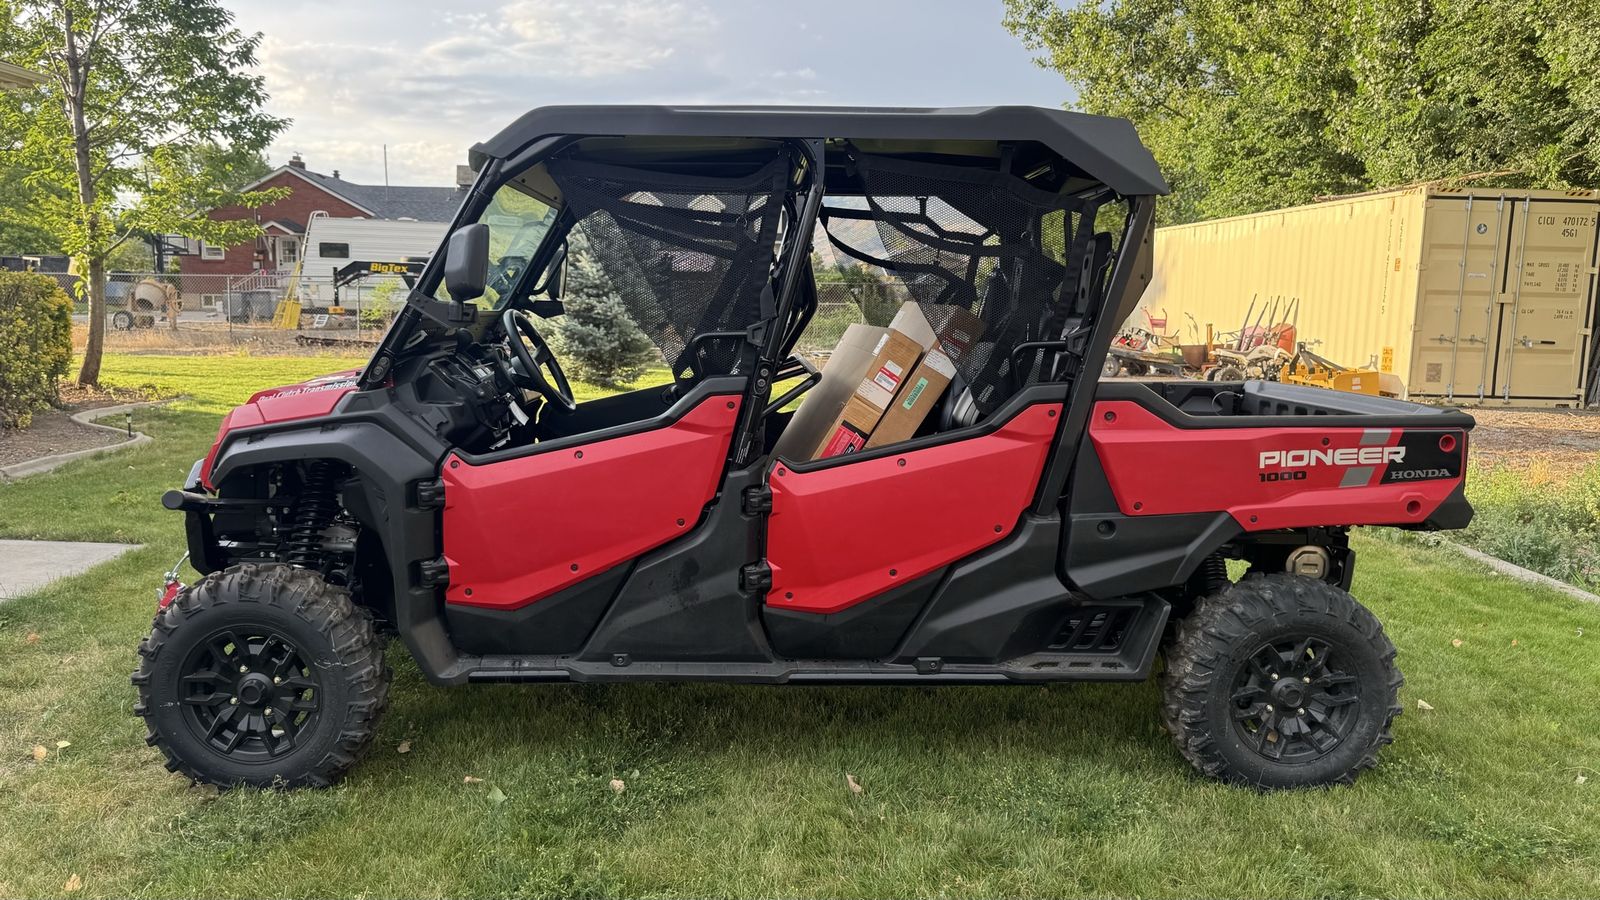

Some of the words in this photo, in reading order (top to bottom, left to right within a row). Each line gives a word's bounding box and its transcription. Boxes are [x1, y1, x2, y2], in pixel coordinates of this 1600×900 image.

[1538, 216, 1555, 225] CICU
[1563, 217, 1589, 226] 470172
[1561, 228, 1578, 238] 45G1
[1259, 446, 1406, 469] PIONEER
[1259, 470, 1307, 482] 1000
[1390, 468, 1452, 480] HONDA
